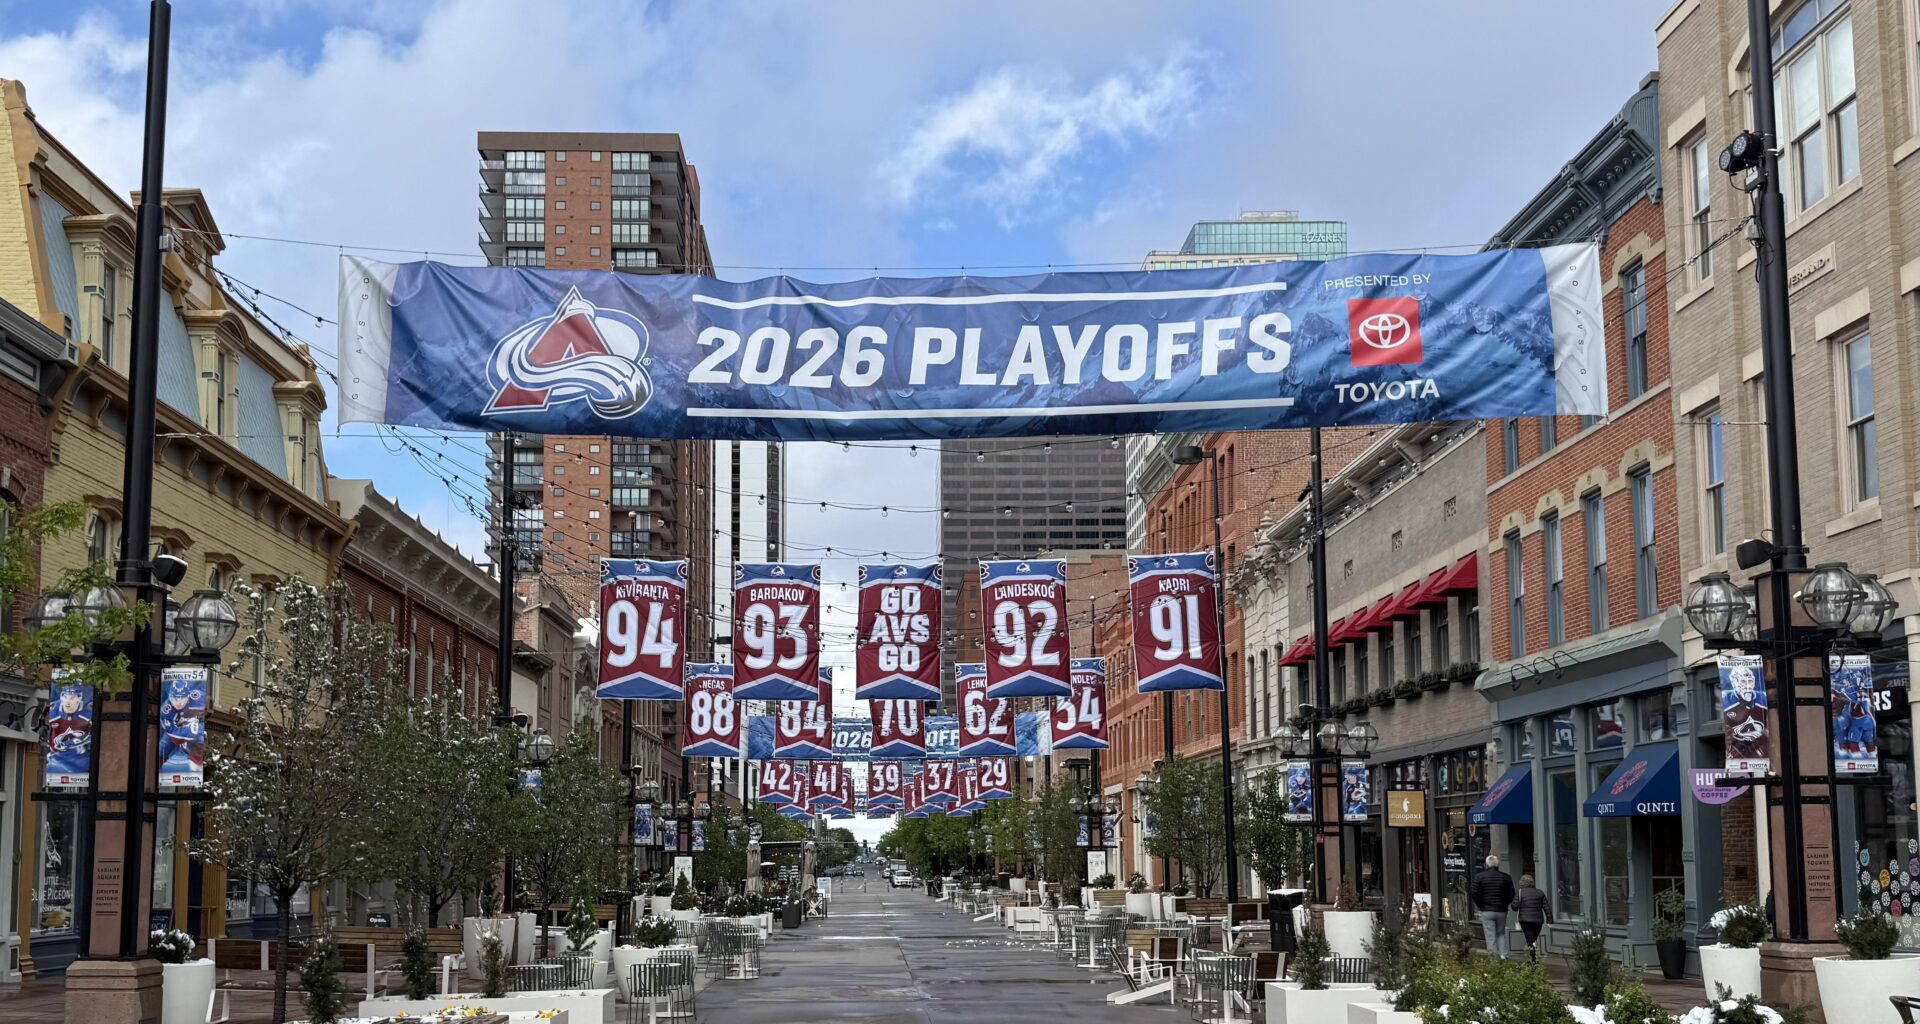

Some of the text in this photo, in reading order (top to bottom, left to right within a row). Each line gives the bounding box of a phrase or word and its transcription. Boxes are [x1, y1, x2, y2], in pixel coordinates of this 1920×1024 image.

[1324, 273, 1431, 290] PRESENTED BY
[351, 277, 370, 400] GO AVS GO
[687, 311, 1292, 389] 2026 PLAYOFFS
[1575, 309, 1584, 345] AVS
[1580, 368, 1588, 392] GO
[1334, 378, 1440, 403] TOYOTA
[616, 583, 669, 600] KIVIRANTA
[750, 587, 805, 602] BARDAKOV
[994, 583, 1055, 600] LANDESKOG
[1158, 577, 1190, 593] KADRI
[880, 586, 921, 614] GO
[606, 600, 678, 669] 94
[743, 602, 809, 670] 93
[868, 614, 930, 644] AVS
[994, 600, 1061, 668] 92
[1150, 594, 1203, 662] 91
[878, 643, 921, 672] GO
[192, 670, 204, 679] 54
[690, 690, 735, 736] 88
[780, 700, 830, 738] 84
[874, 700, 919, 737] 70
[964, 690, 1008, 736] 62
[1056, 686, 1102, 731] 54
[763, 762, 791, 791] 42
[814, 765, 837, 792] 41
[872, 764, 899, 792] 39
[927, 762, 953, 790] 37
[981, 759, 1007, 787] 29
[1472, 812, 1485, 823] QINTI
[1597, 803, 1615, 815] QINTI
[1637, 802, 1675, 814] QINTI
[47, 887, 71, 901] PIGEON
